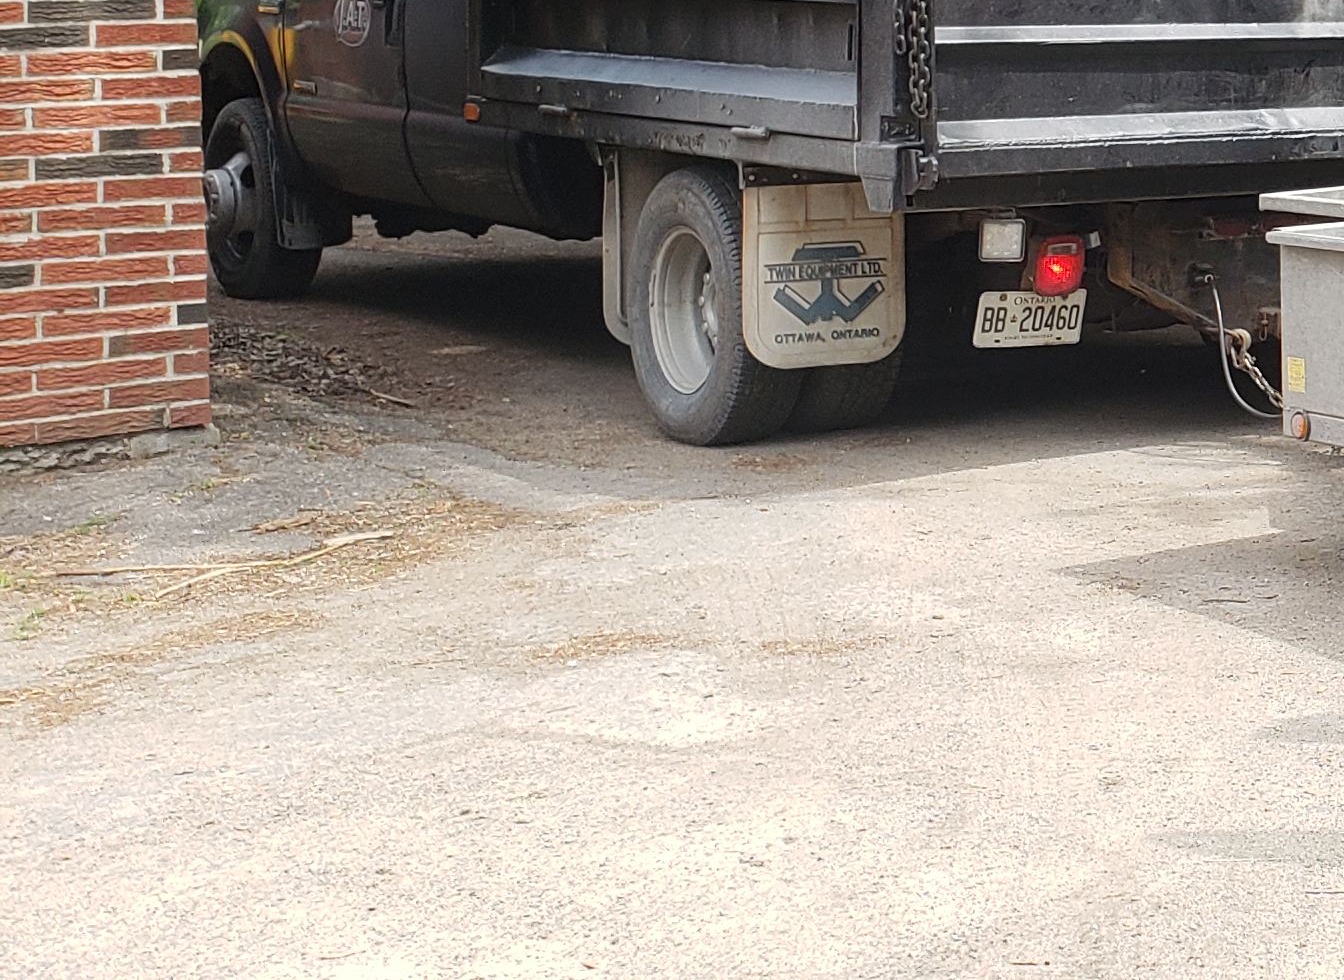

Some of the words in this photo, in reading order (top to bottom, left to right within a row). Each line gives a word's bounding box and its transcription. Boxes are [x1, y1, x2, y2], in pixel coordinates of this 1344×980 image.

[767, 266, 797, 281] TWIN
[799, 263, 858, 280] EQUIPMENT
[860, 260, 884, 276] LTD.
[981, 306, 1008, 334] BB
[1019, 303, 1080, 333] 20460
[774, 331, 826, 345] OTTAWA,
[830, 327, 880, 341] ONTARIO
